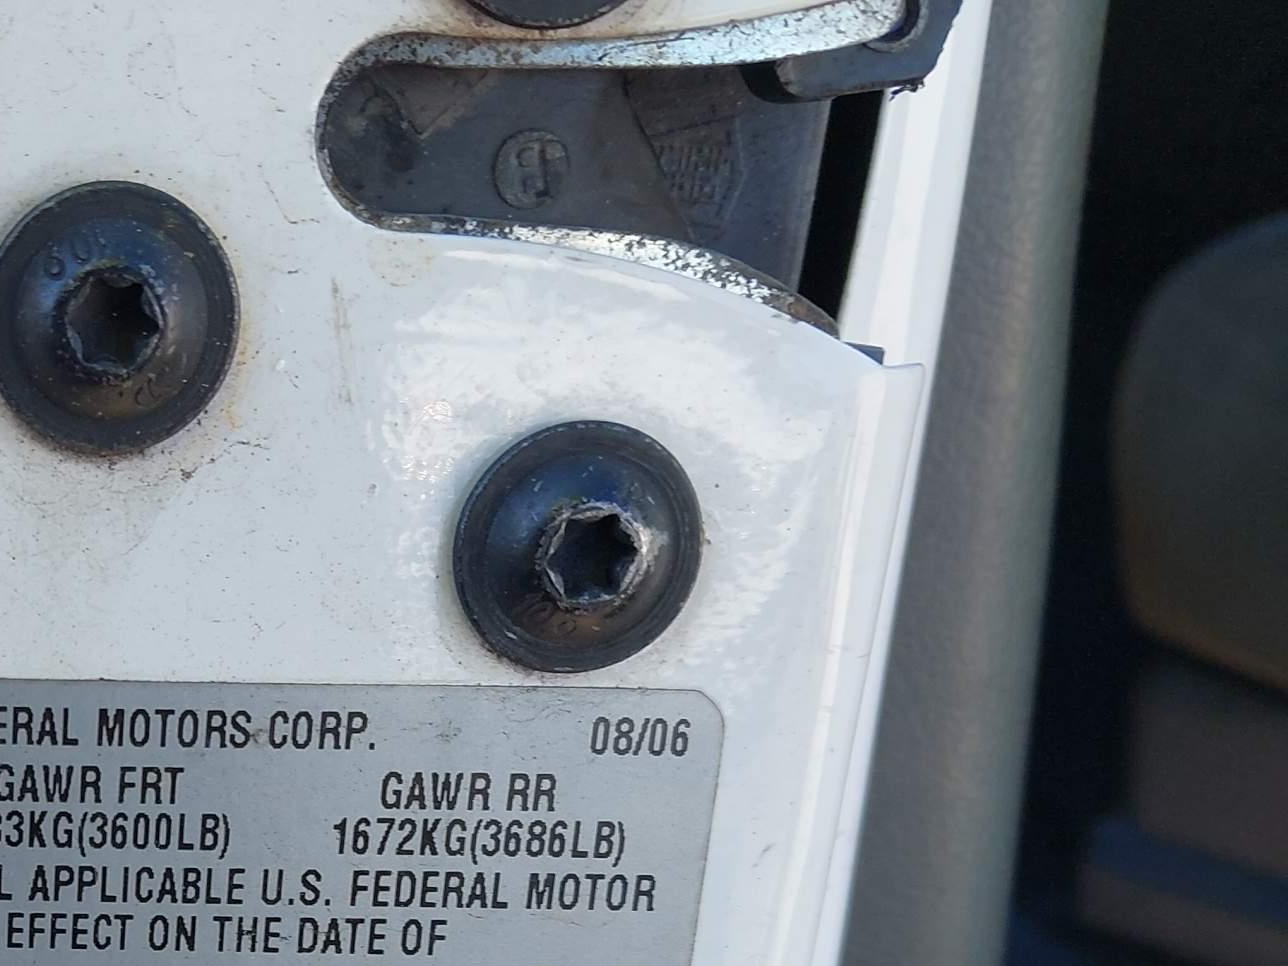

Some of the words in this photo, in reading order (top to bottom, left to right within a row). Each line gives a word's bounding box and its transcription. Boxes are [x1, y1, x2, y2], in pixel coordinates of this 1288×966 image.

[97, 709, 252, 748] MOTORS
[268, 711, 375, 750] CORP.
[590, 717, 691, 757] 08/06
[118, 767, 184, 804] FRT
[381, 772, 491, 810] GAWR
[506, 773, 556, 812] RR
[333, 817, 625, 867] 1672KG(3686LB)
[29, 865, 245, 904] APPLICABLE
[261, 869, 330, 906] U.S.
[350, 870, 508, 909] FEDERAL
[526, 873, 656, 911] MOTOR
[7, 912, 134, 950] EFFECT
[149, 915, 196, 951] ON
[214, 917, 282, 954] THE
[297, 918, 387, 955] DATE
[401, 919, 447, 955] OF
